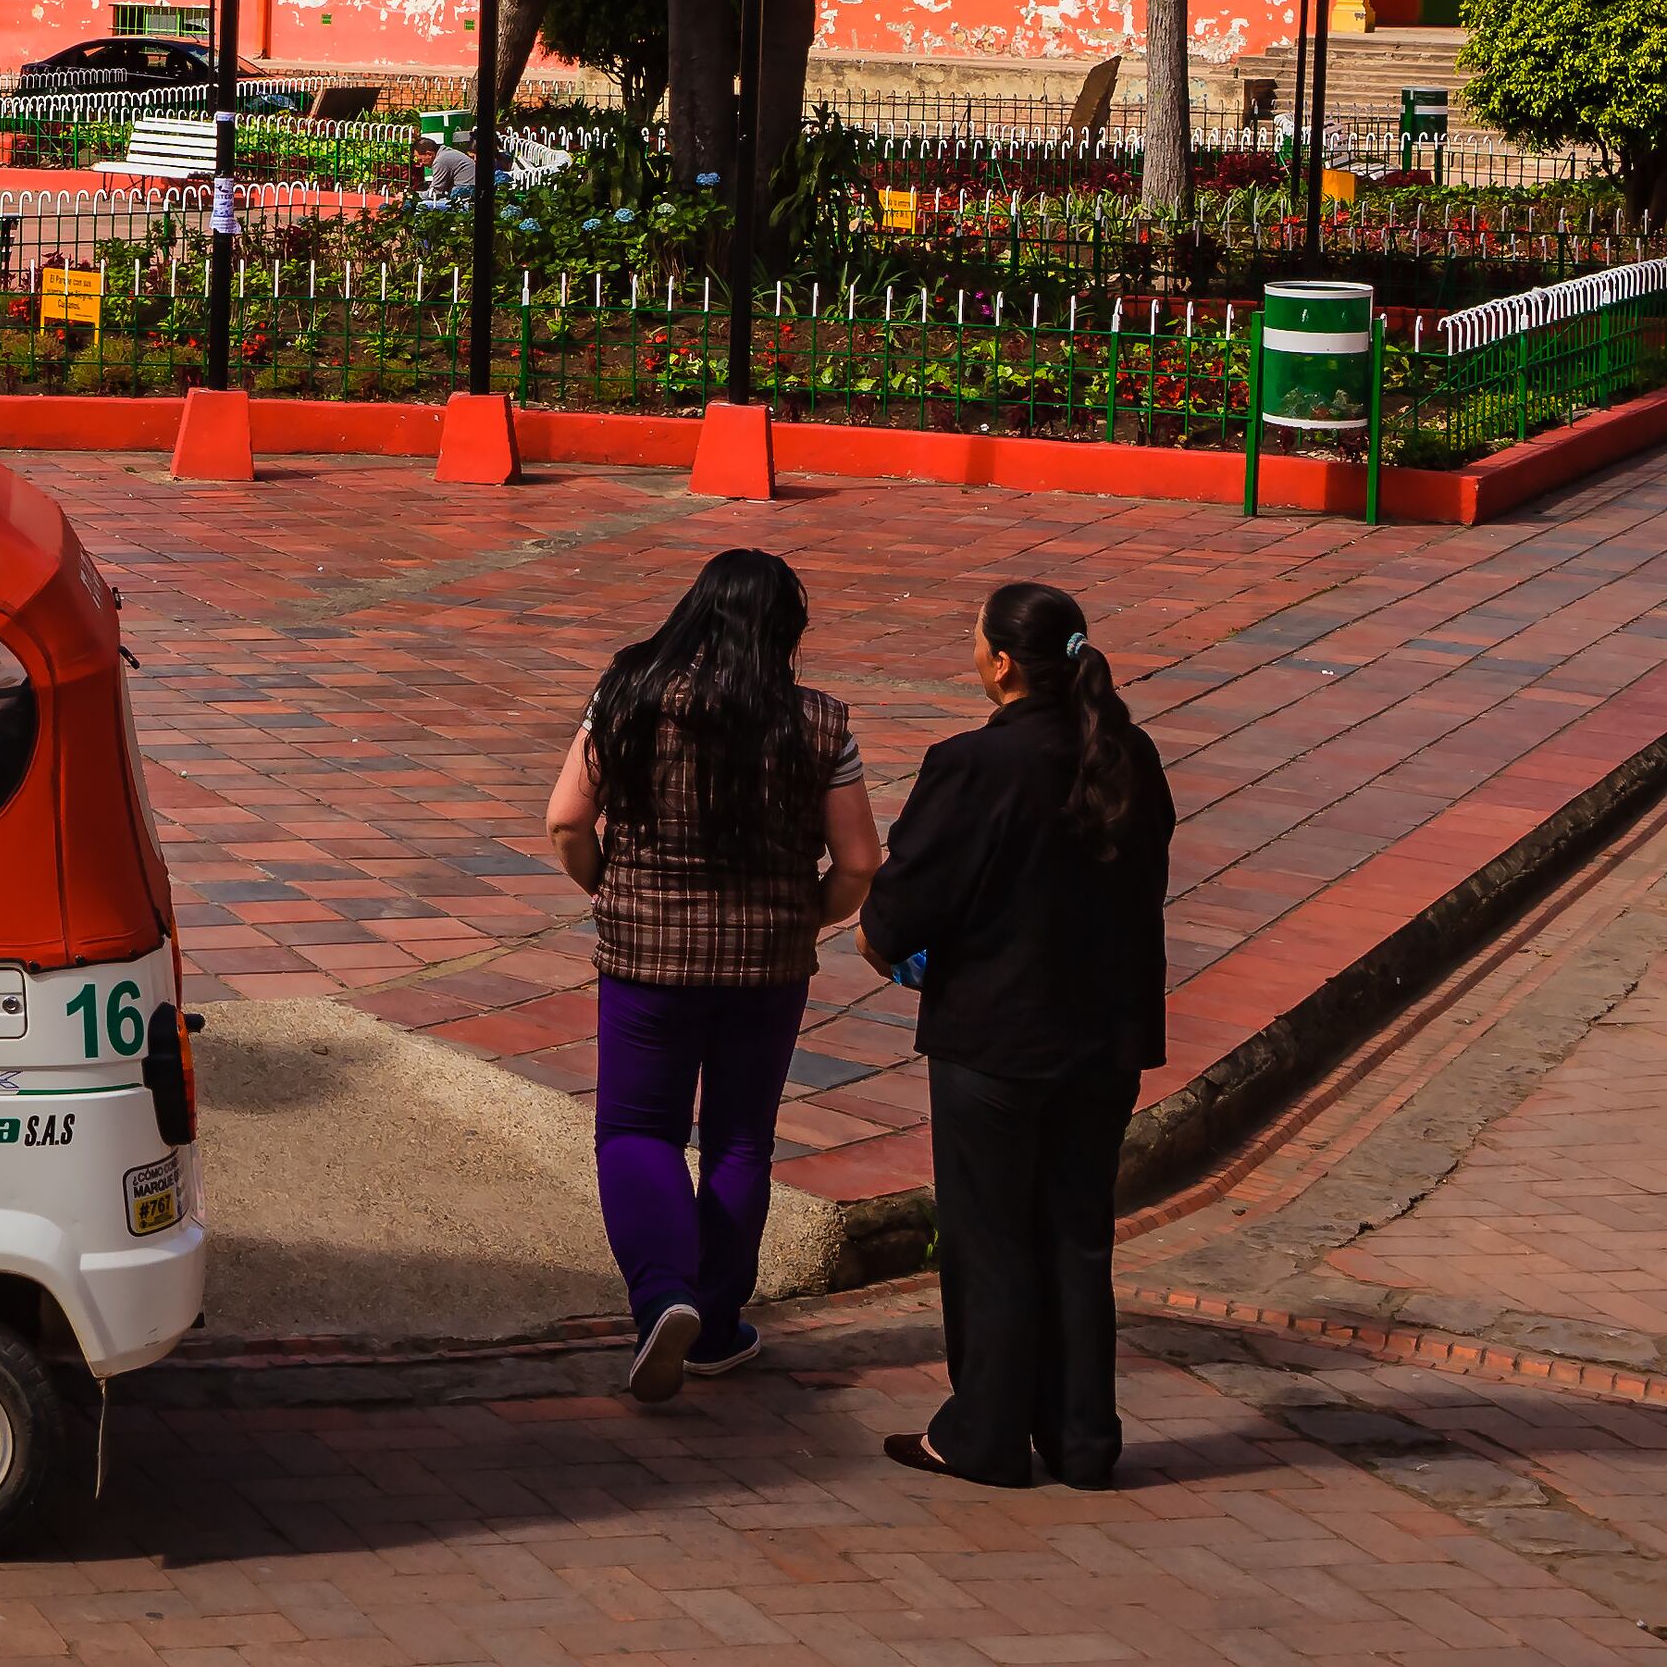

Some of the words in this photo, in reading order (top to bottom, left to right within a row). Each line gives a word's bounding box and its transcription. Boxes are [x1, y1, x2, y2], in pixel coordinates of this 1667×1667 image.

[65, 980, 145, 1059] 16
[24, 1113, 76, 1147] S.A.S
[133, 1173, 175, 1199] MARQUE
[139, 1193, 172, 1219] #767
